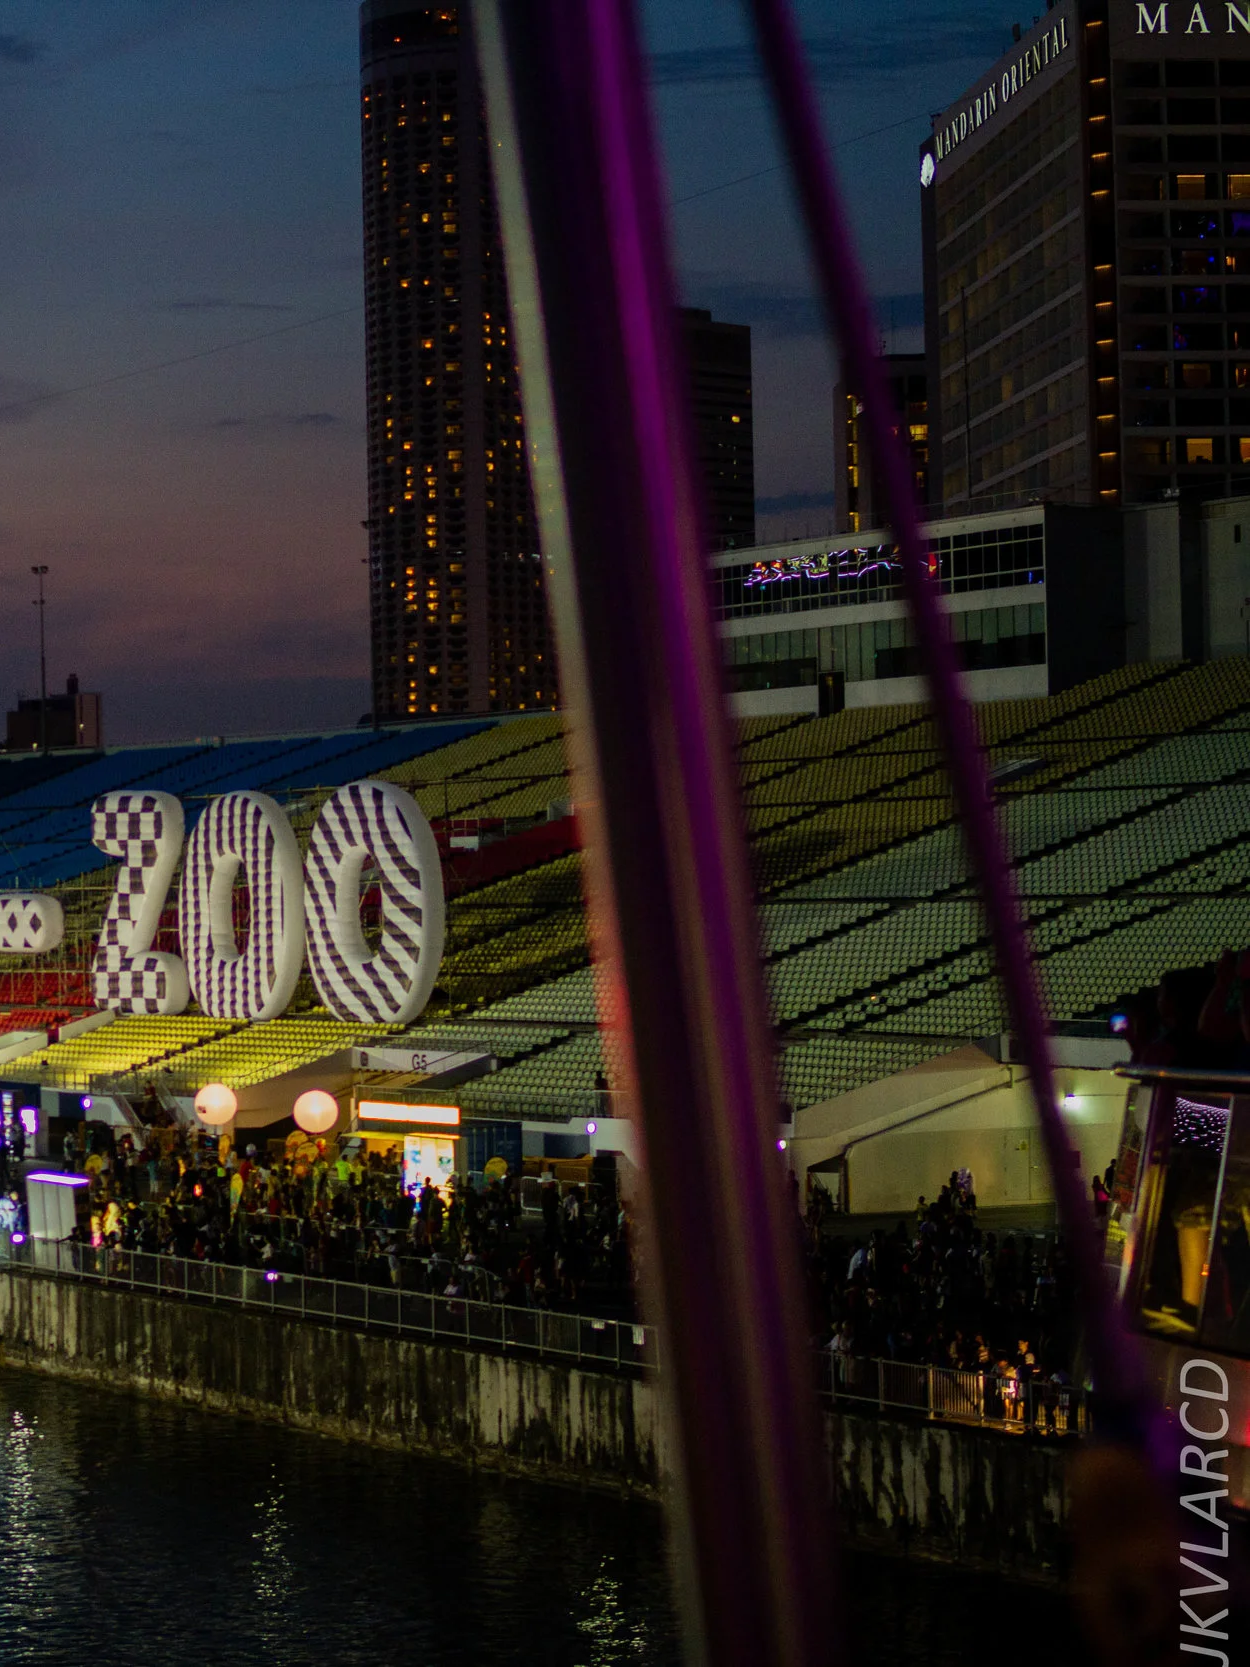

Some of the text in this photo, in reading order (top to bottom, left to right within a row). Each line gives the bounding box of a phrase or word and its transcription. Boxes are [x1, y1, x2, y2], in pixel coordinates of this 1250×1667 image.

[935, 17, 1068, 162] MANDARIN ORIENTAL
[411, 1053, 428, 1071] G5
